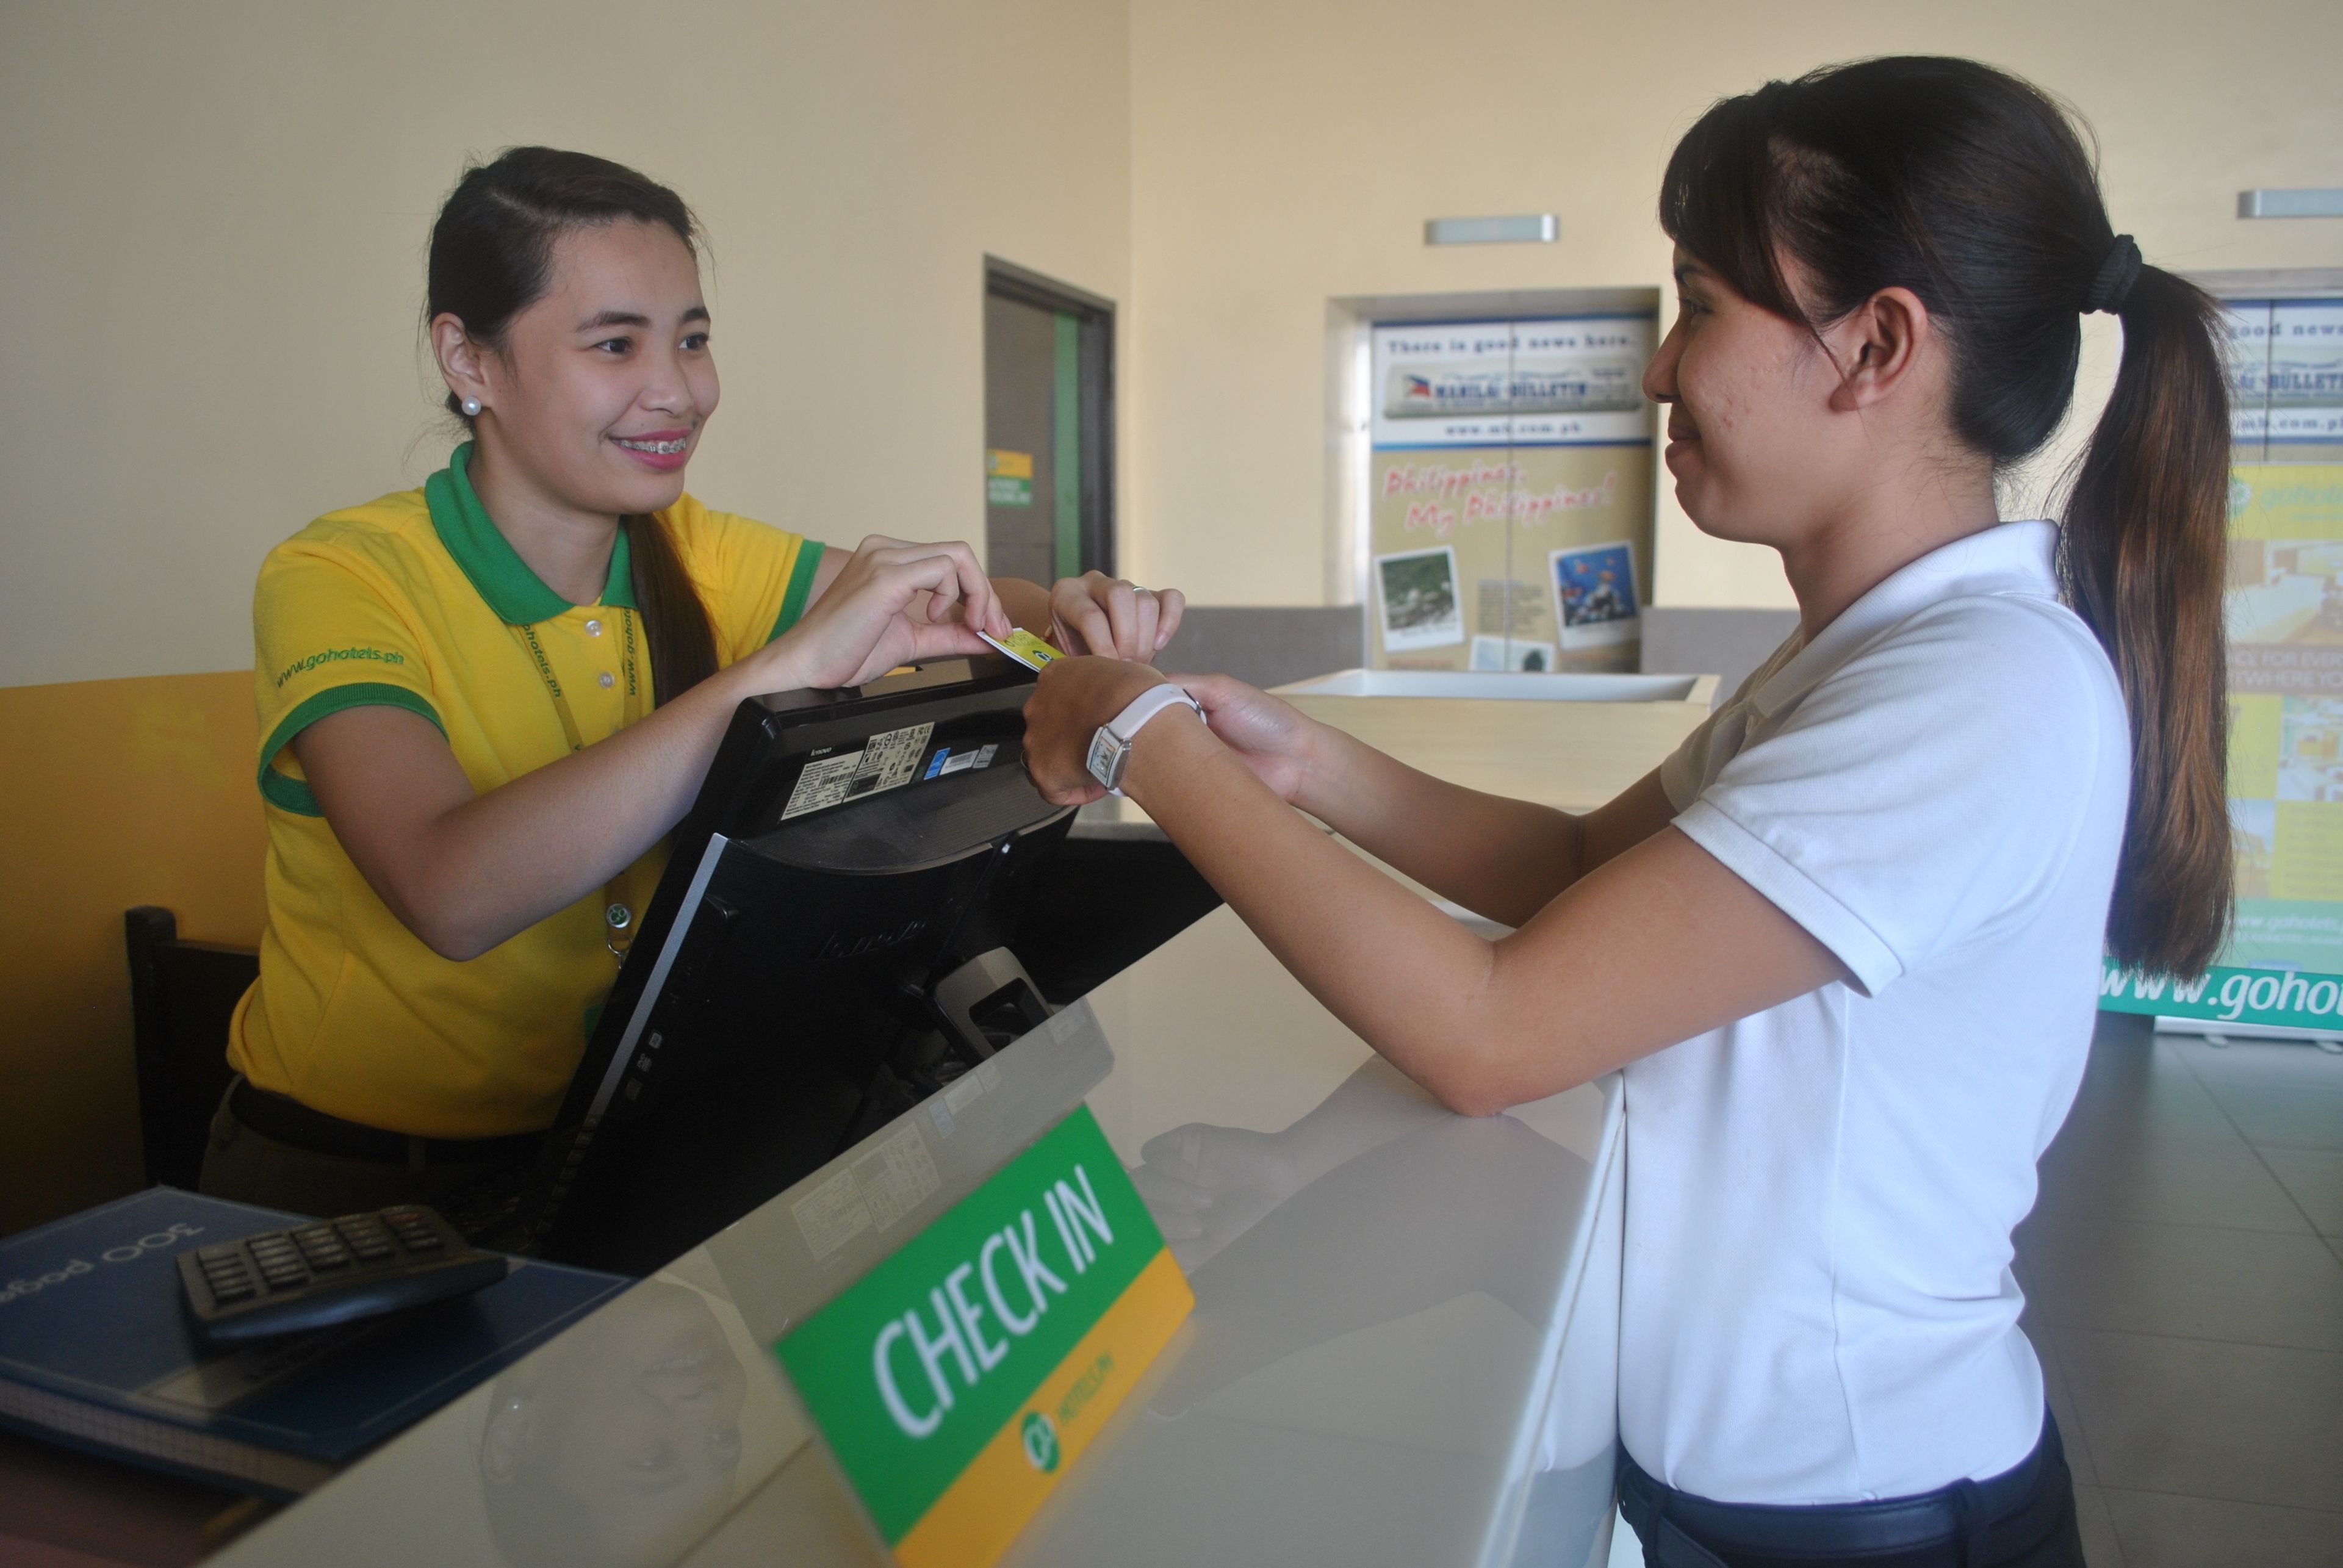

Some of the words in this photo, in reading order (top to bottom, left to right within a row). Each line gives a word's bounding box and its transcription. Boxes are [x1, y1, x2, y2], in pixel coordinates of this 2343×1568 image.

[1388, 340, 1441, 353] There
[1450, 339, 1466, 351] is
[1474, 336, 1519, 354] good
[1528, 336, 1577, 349] news
[277, 646, 404, 688] www.gohotels.ph
[873, 1209, 1068, 1439] CHECK
[1044, 1163, 1114, 1275] IN
